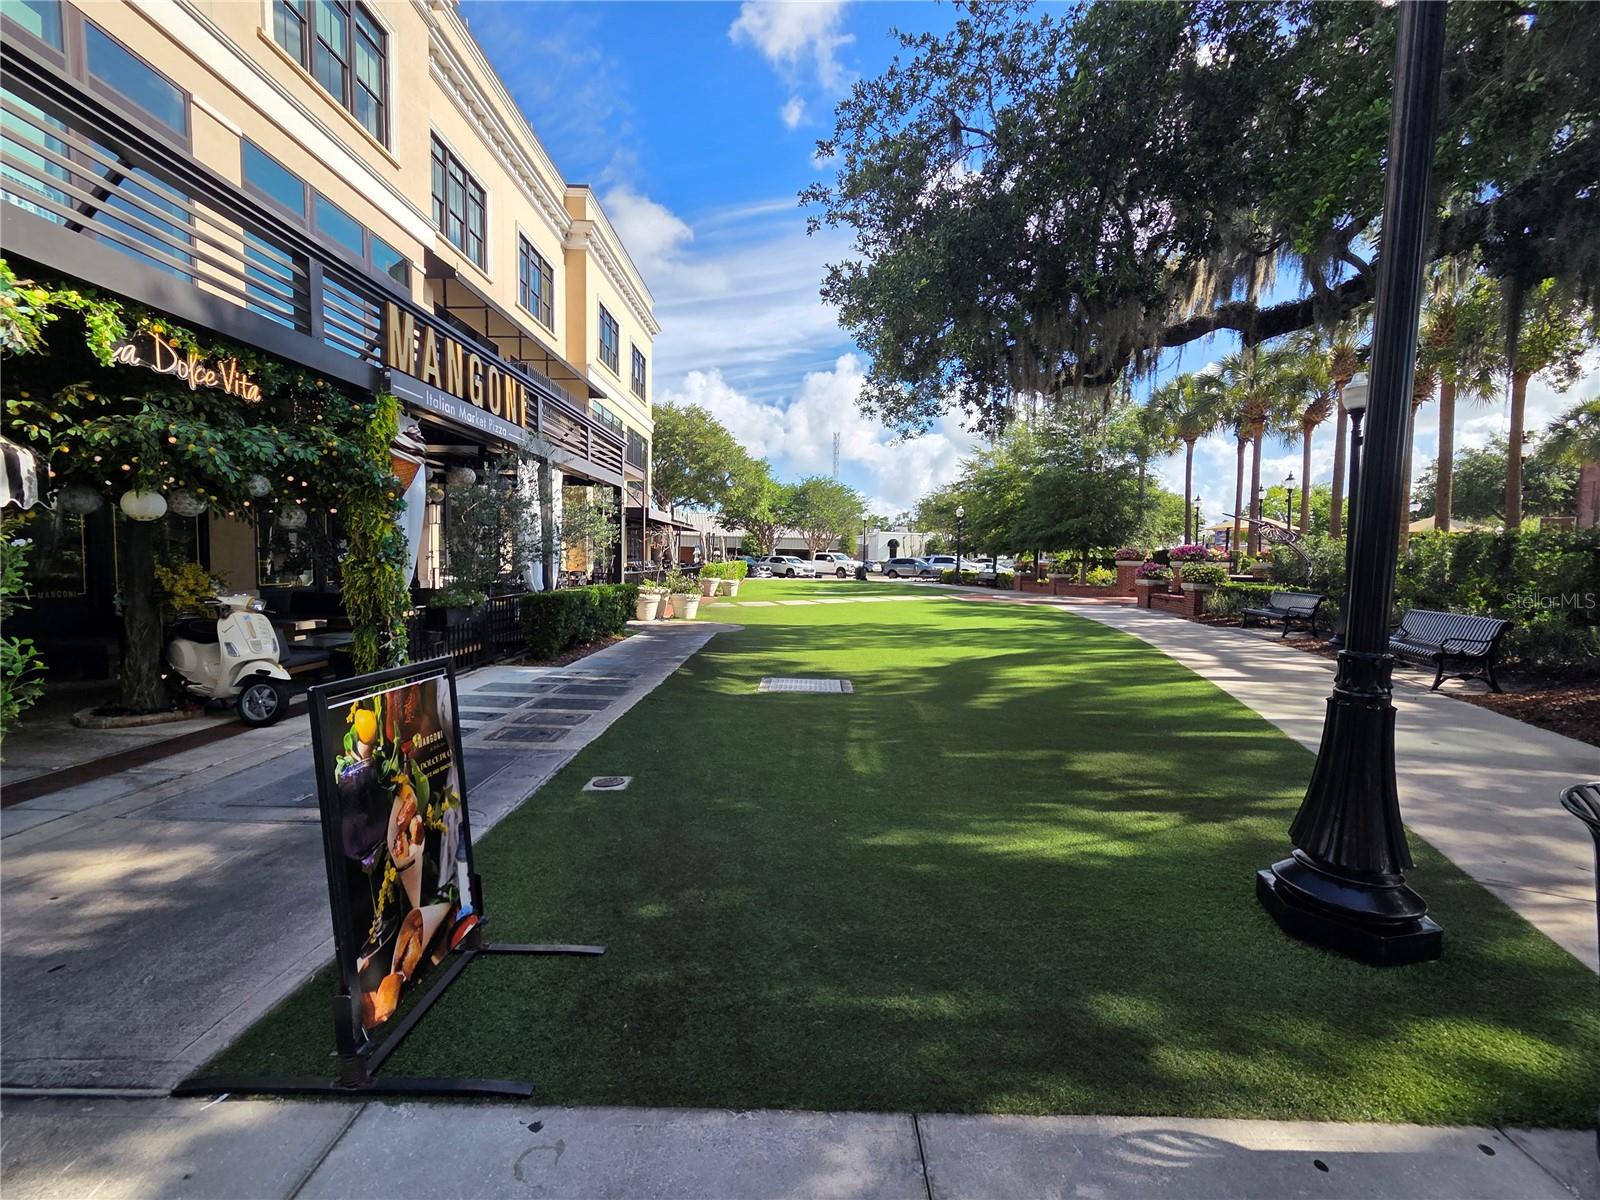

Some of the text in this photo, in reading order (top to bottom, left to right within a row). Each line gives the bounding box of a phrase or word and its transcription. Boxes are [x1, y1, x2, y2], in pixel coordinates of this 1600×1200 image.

[148, 331, 218, 390] Dolce
[218, 357, 262, 402] Vita
[387, 300, 526, 428] MANGONI
[426, 390, 508, 437] Italian Market Pizza
